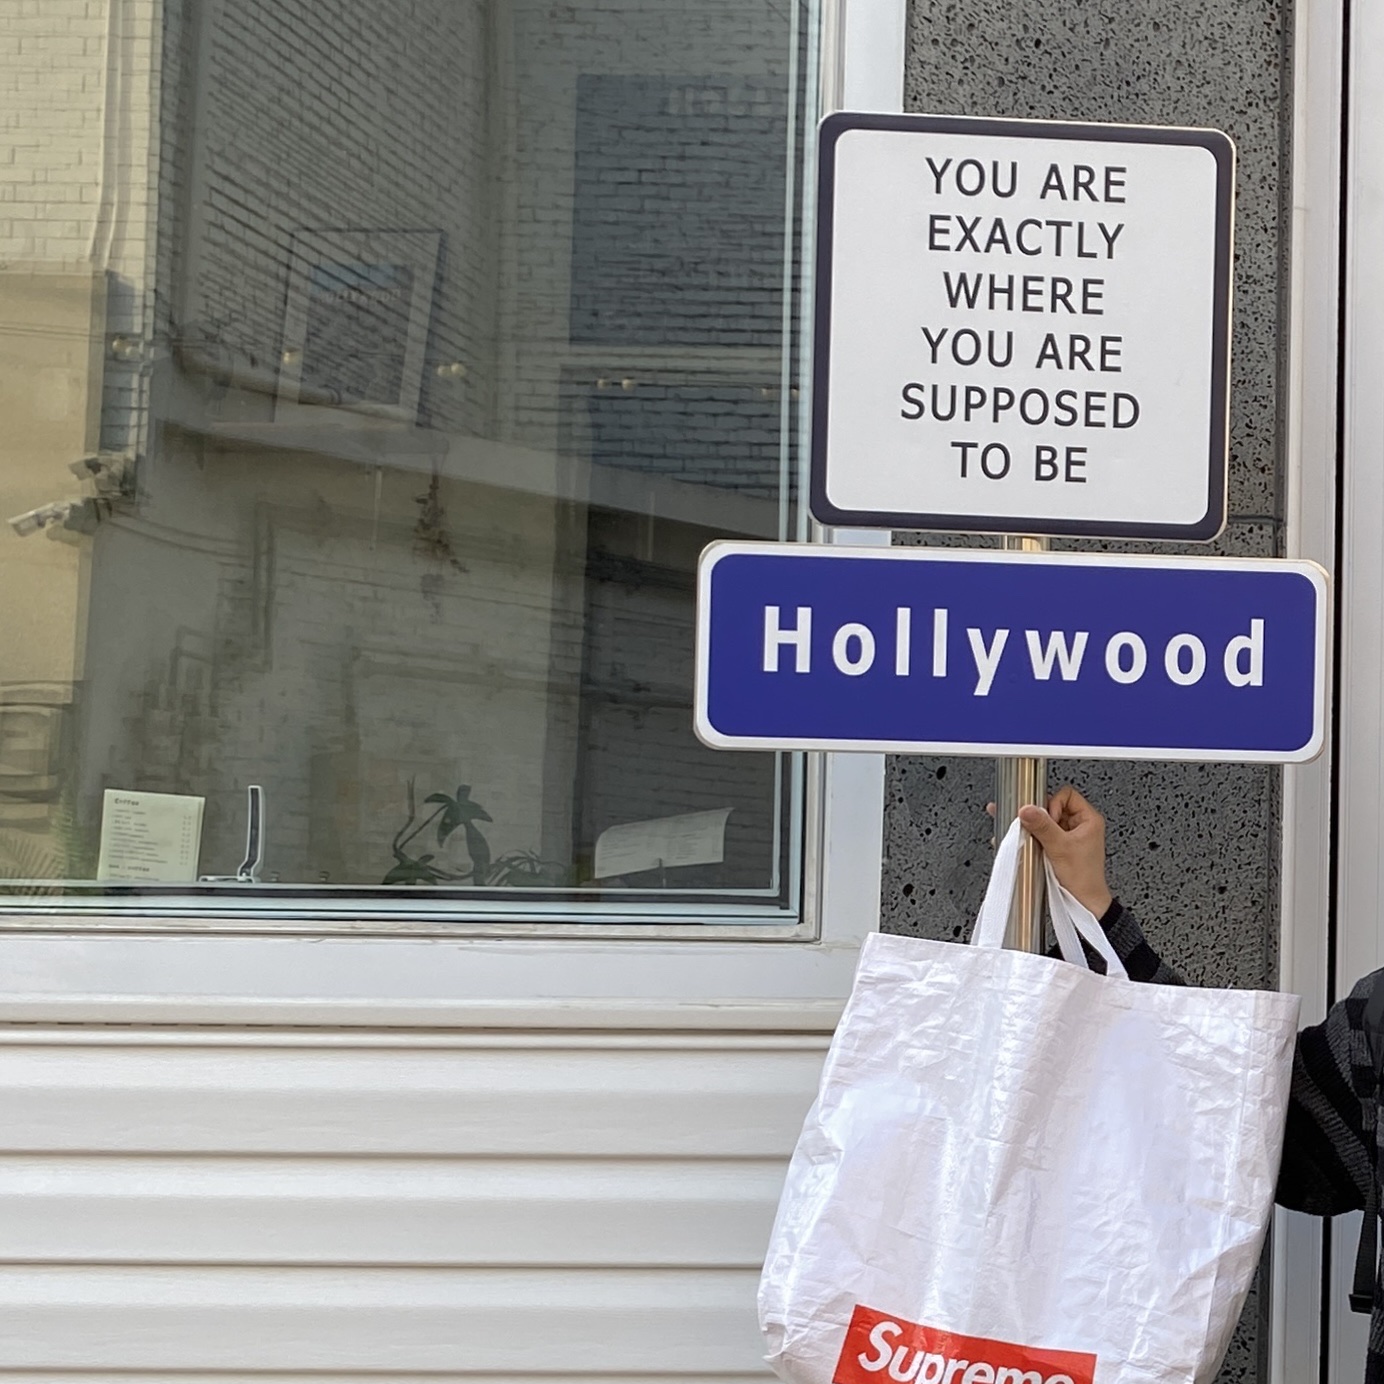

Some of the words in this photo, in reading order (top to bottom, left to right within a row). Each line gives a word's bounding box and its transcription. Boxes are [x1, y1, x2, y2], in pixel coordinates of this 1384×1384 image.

[925, 157, 1018, 198] YOU
[1039, 164, 1128, 203] ARE
[928, 214, 1125, 260] EXACTLY
[942, 271, 1105, 316] WHERE
[921, 326, 1014, 368] YOU
[1035, 333, 1123, 373] ARE
[900, 382, 1141, 429] SUPPOSED
[950, 441, 1011, 481] TO
[1034, 445, 1088, 484] BE
[762, 605, 1266, 697] Hollywood
